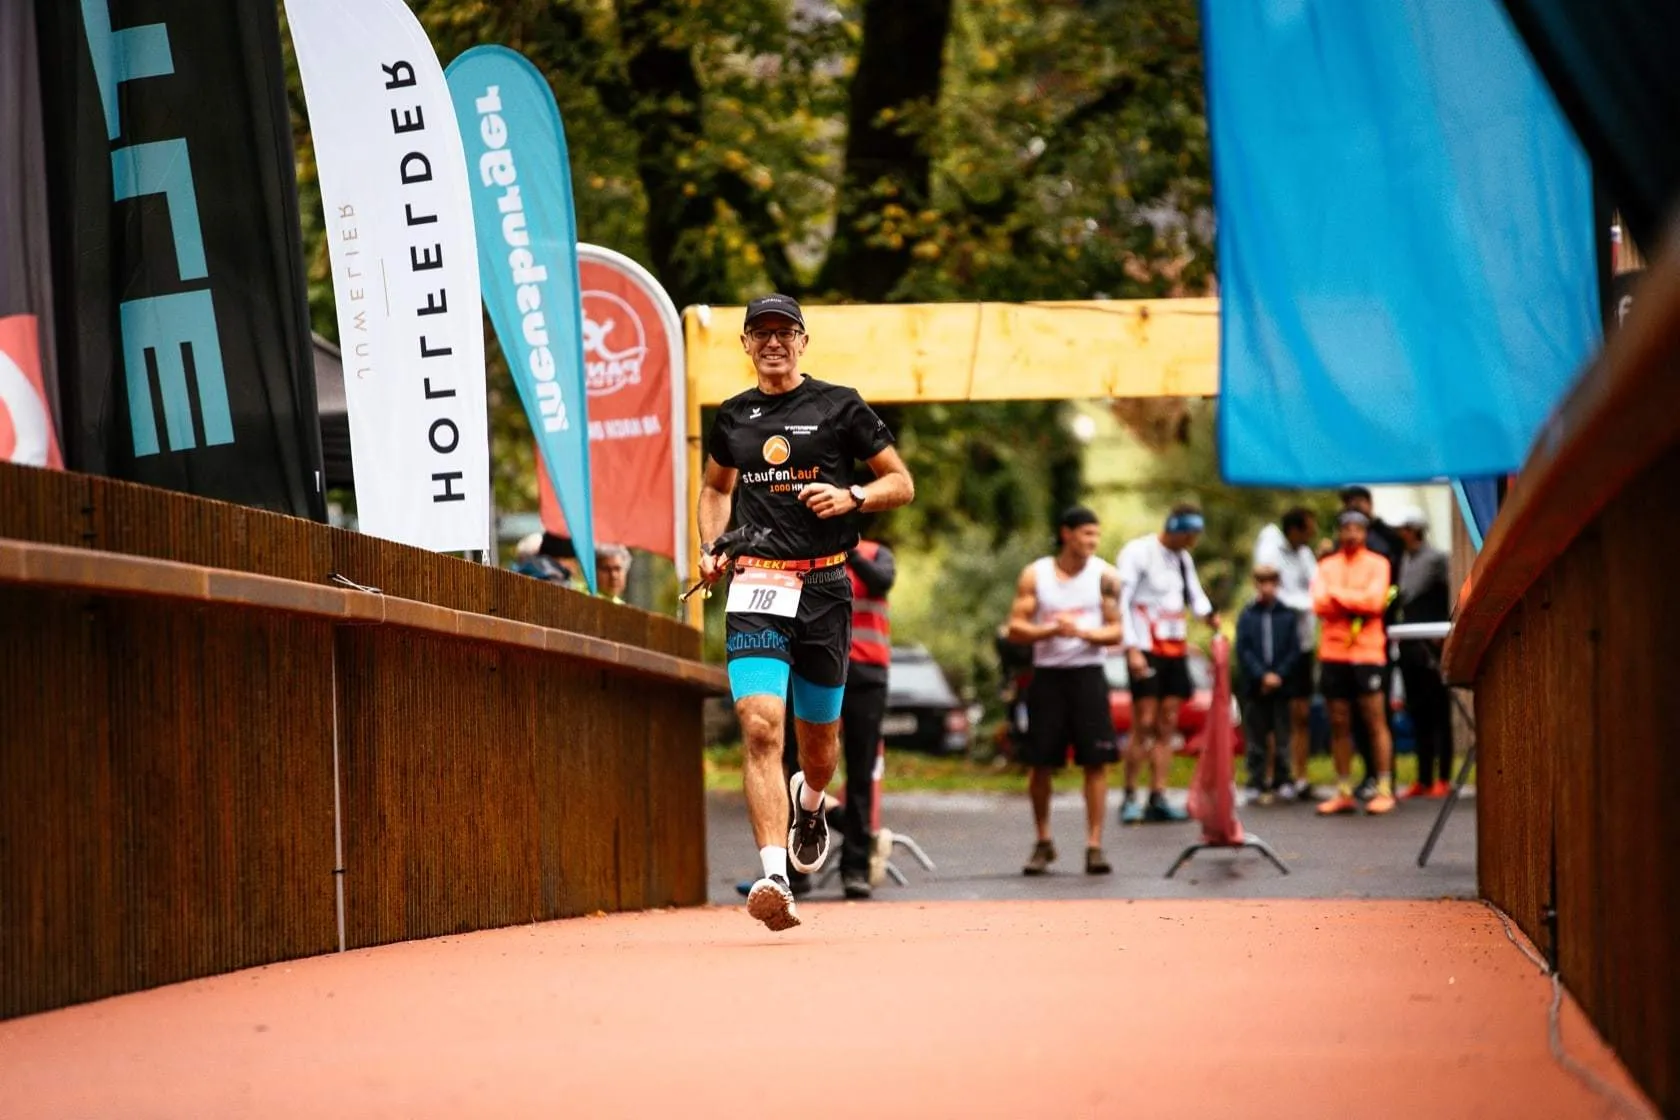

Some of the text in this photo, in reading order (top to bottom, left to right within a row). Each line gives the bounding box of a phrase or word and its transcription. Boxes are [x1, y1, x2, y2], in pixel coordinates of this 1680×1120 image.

[769, 483, 791, 493] 1000
[755, 559, 786, 569] LEKI
[747, 588, 778, 610] 118
